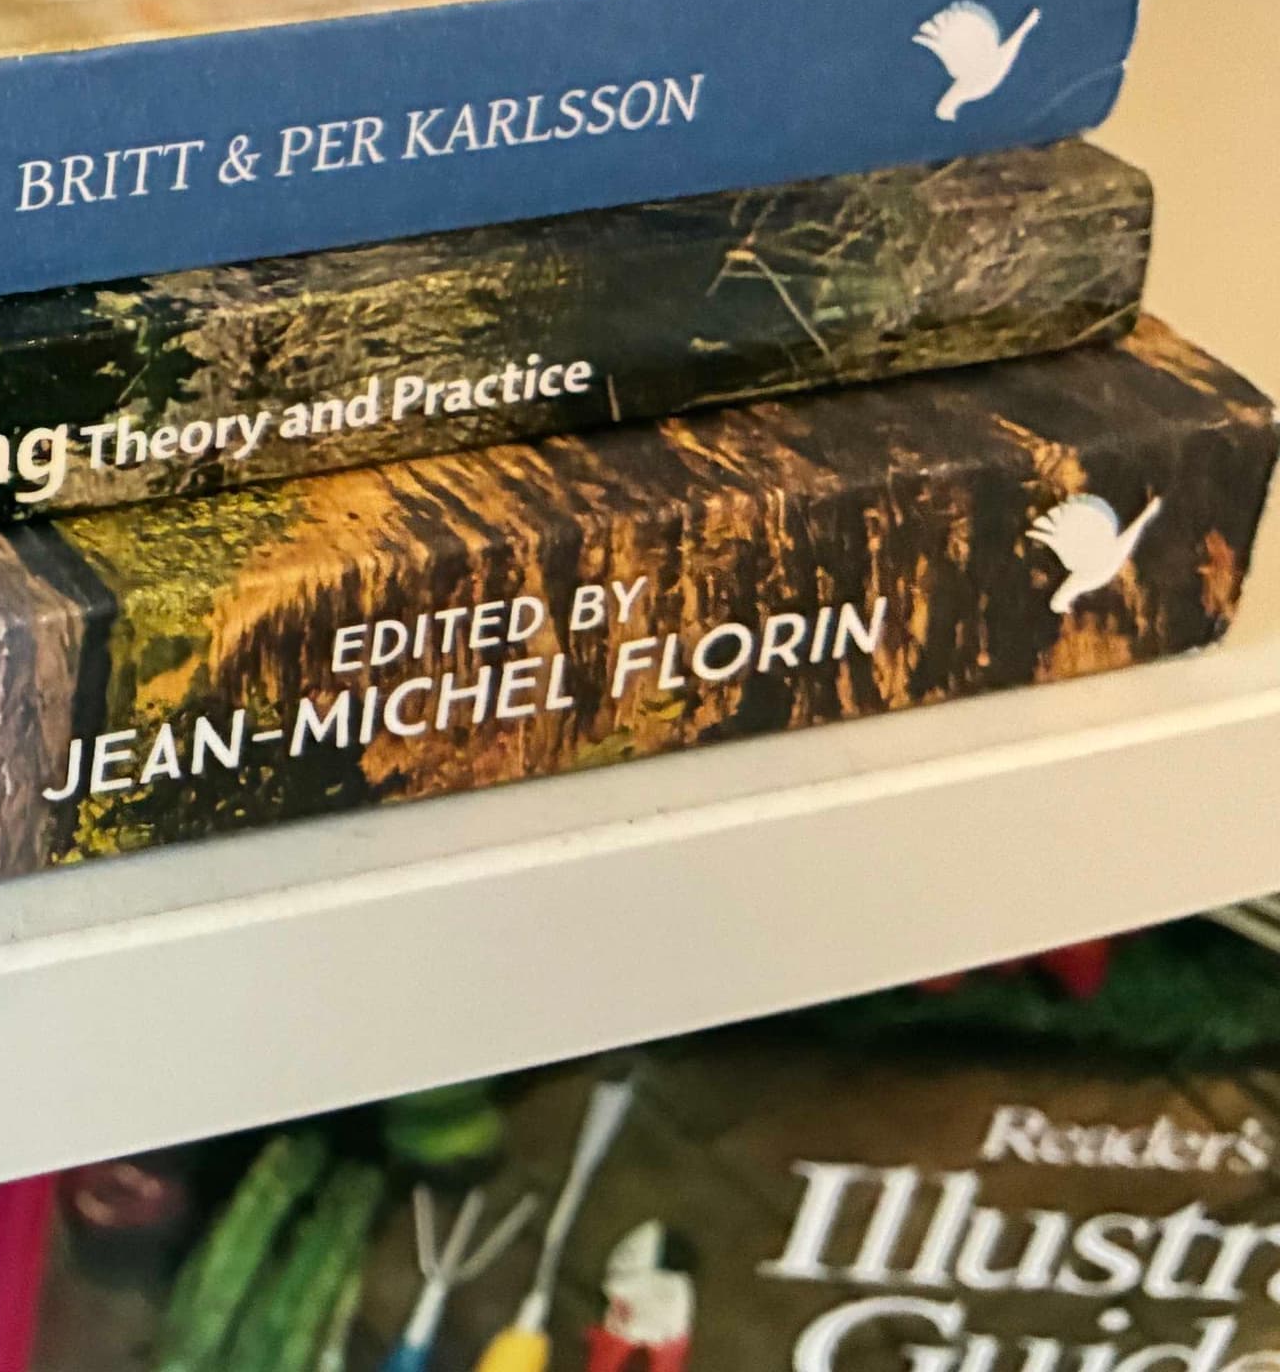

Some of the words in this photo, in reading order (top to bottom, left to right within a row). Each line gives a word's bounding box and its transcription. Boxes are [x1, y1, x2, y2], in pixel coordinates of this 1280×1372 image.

[13, 139, 205, 213] BRITT
[217, 134, 262, 186] &
[274, 115, 387, 178] PER
[401, 72, 708, 162] KARLSSON
[80, 411, 270, 472] Theory
[279, 379, 381, 439] and
[392, 352, 593, 423] Practice
[331, 597, 546, 676] EDITED
[569, 575, 649, 632] BY
[42, 650, 575, 804] JEAN-MICHEL
[610, 597, 890, 699] FLORIN
[980, 1104, 1272, 1173] Reader's
[755, 1158, 1279, 1301] Illustr
